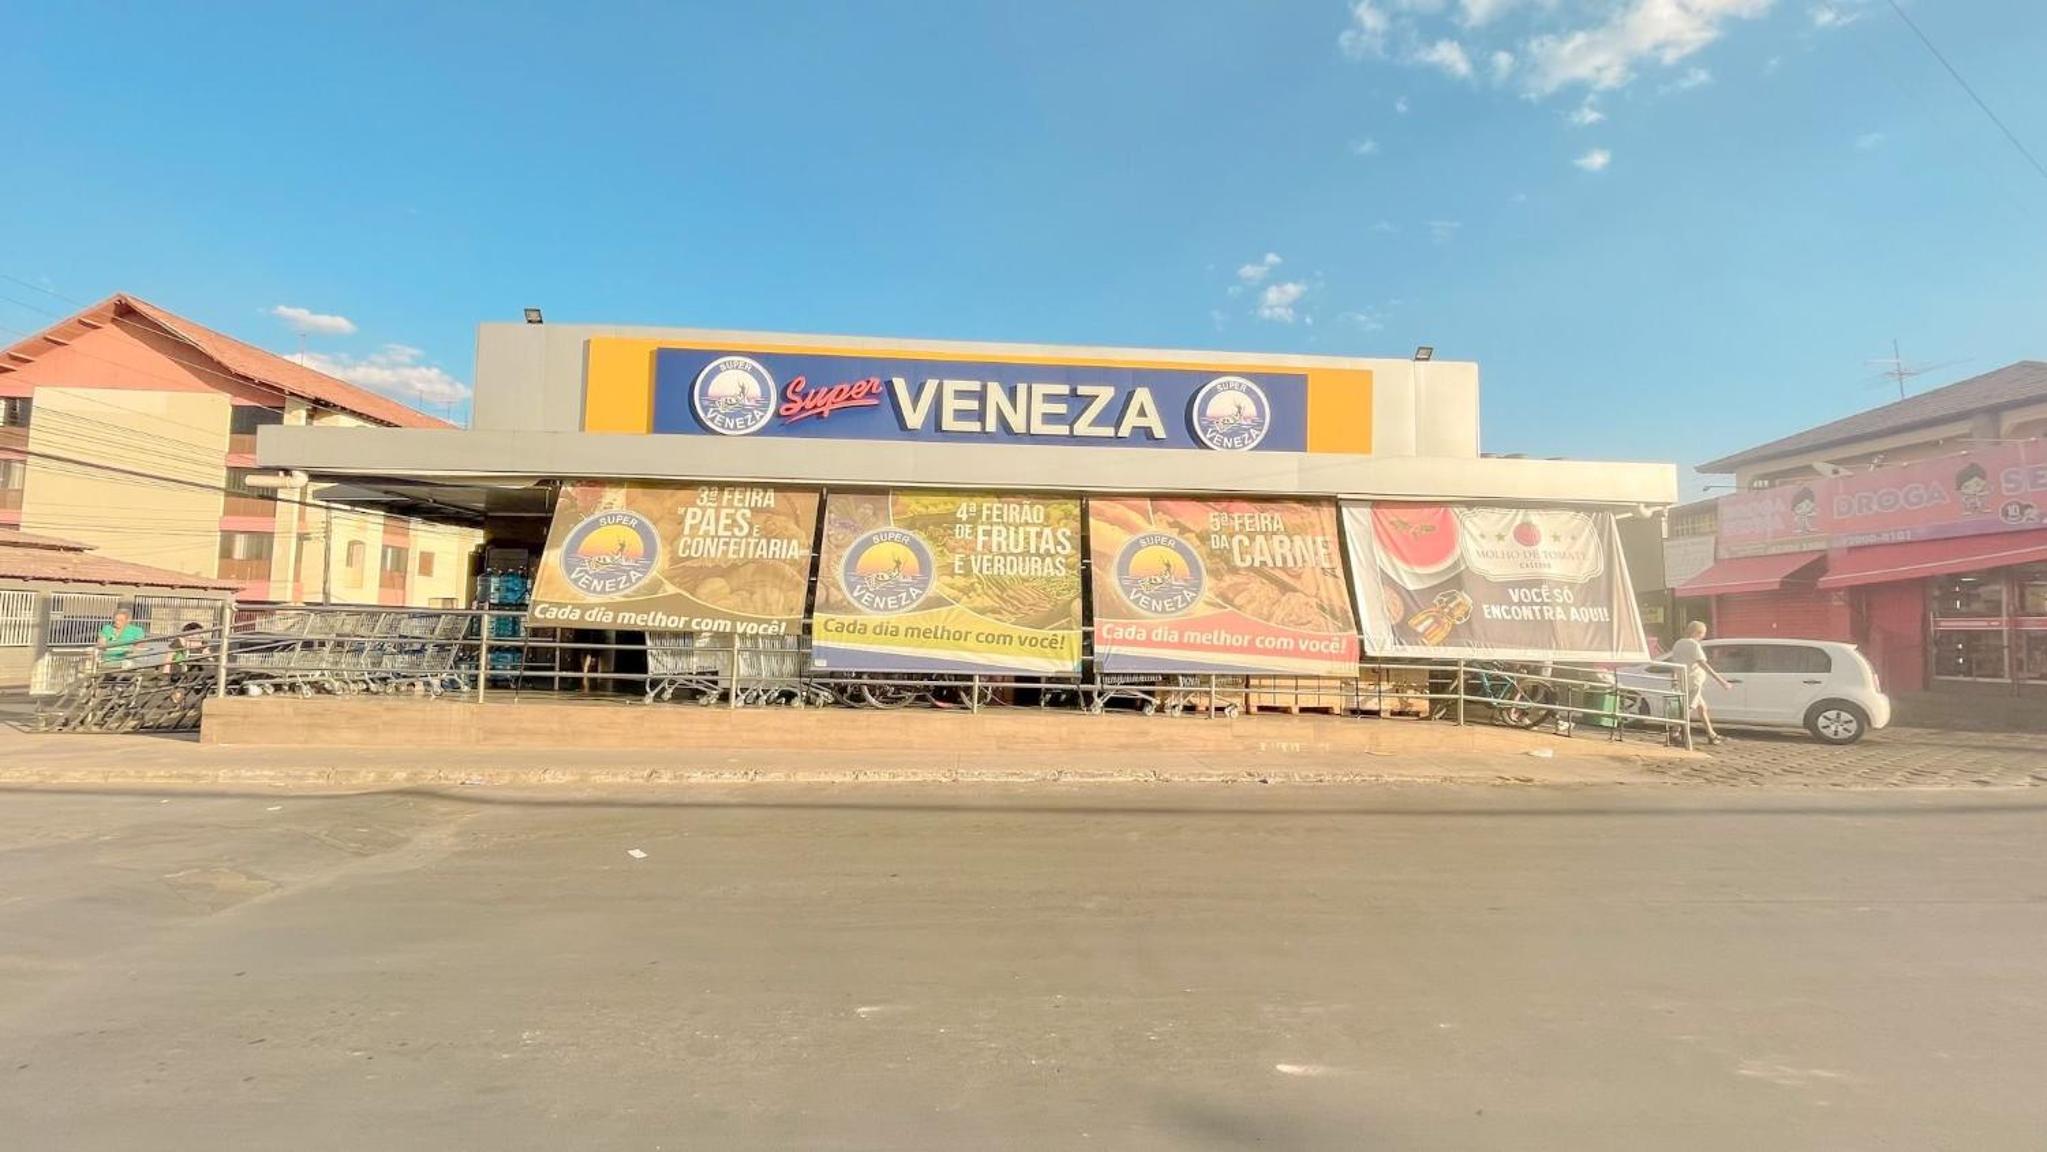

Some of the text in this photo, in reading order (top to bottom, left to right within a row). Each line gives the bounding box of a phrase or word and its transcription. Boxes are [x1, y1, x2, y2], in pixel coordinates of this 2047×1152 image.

[719, 360, 752, 372] SUPER
[1216, 381, 1247, 392] SUPER
[706, 407, 765, 429] VENEZA
[779, 376, 1166, 439] Super VENEZA
[1206, 427, 1261, 449] VENEZA
[722, 486, 775, 508] FEIRA
[1833, 481, 1951, 520] DROGA
[599, 513, 639, 528] SUPER
[981, 500, 1045, 524] FEIRÃO
[1234, 513, 1285, 532] FEIRA
[752, 525, 761, 537] E
[872, 531, 910, 544] SUPER
[955, 523, 1072, 555] DE FRUTAS
[1140, 536, 1175, 548] SUPER
[678, 537, 799, 560] CONFEITARIA
[1211, 534, 1333, 569] DA CARNE
[954, 554, 1067, 578] E VERDURAS
[571, 568, 643, 593] VENEZA
[852, 585, 923, 610] VENEZA
[1129, 590, 1197, 612] VENEZA
[1508, 584, 1575, 603] VOCÊ SÓ
[534, 603, 787, 636] Cada dia melhor com você!
[1483, 604, 1611, 624] ENCONTRA AQUI!
[823, 617, 1066, 651] Cada dia melhor com você!
[1102, 623, 1348, 655] Cada dia melhor com você!
